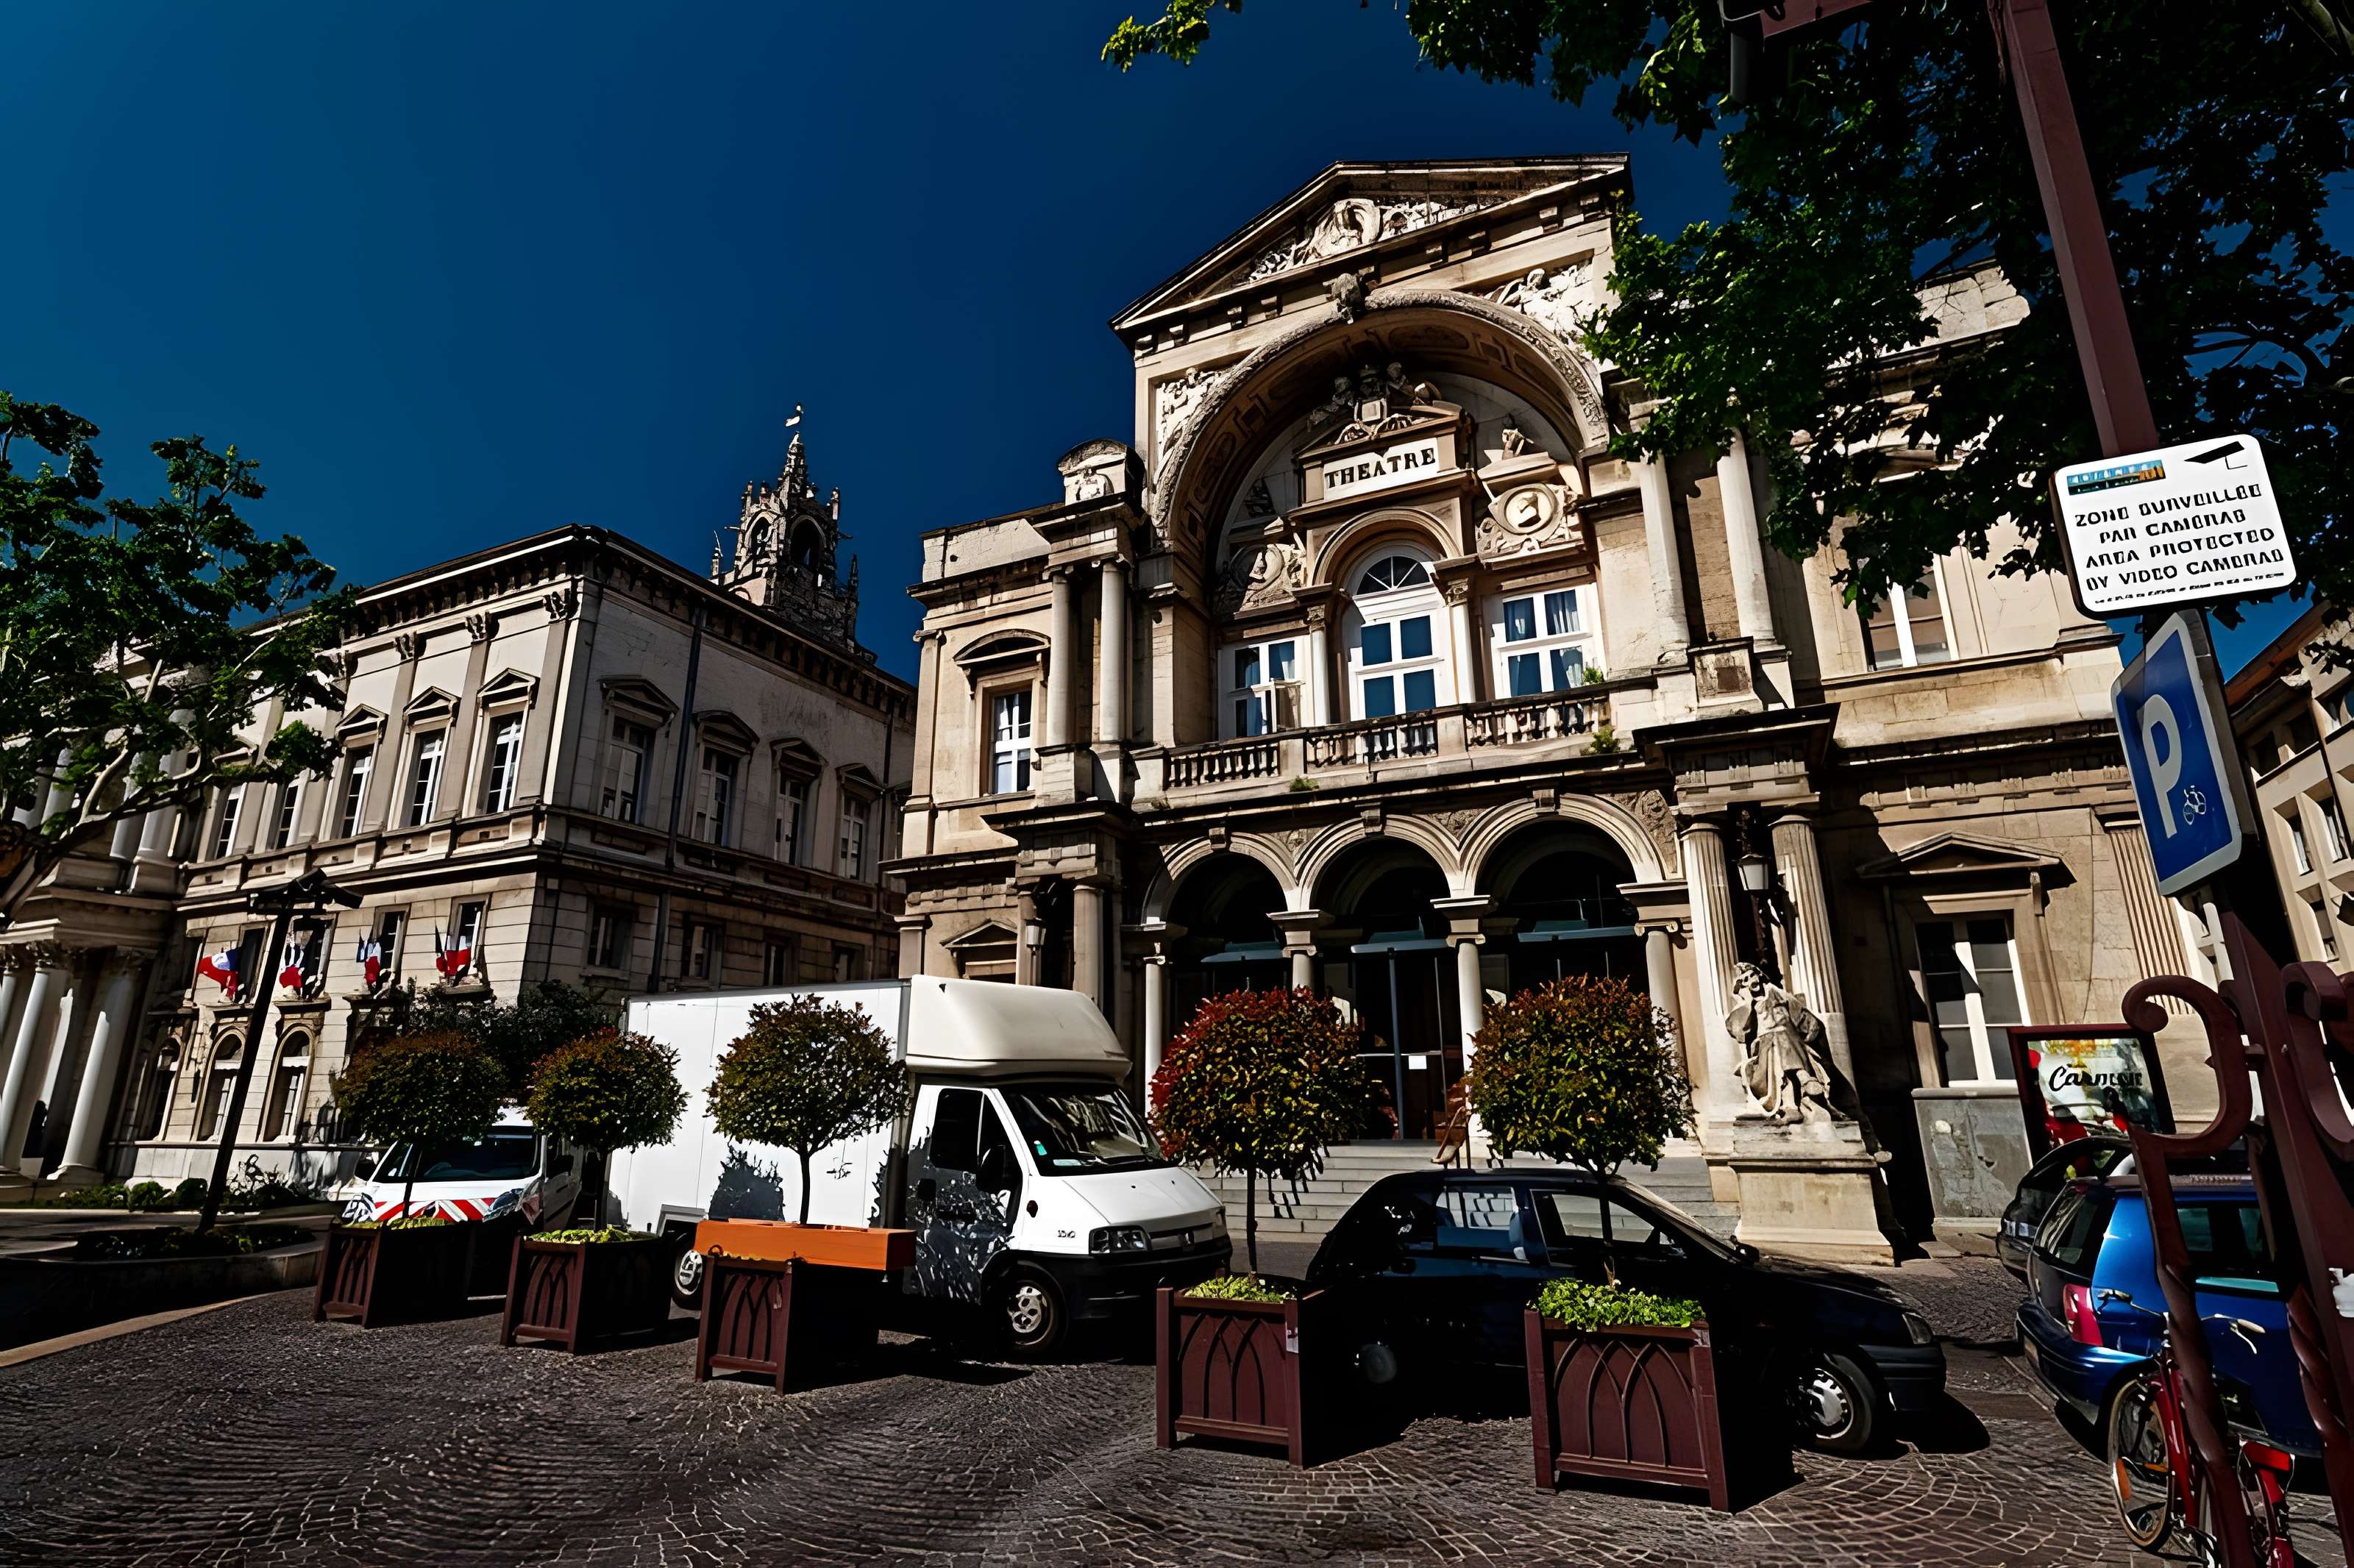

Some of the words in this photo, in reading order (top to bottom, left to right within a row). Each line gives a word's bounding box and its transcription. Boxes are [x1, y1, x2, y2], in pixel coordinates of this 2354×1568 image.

[1325, 447, 1436, 488] THEATRE
[2119, 565, 2177, 585] VIDEO
[2136, 694, 2183, 838] P
